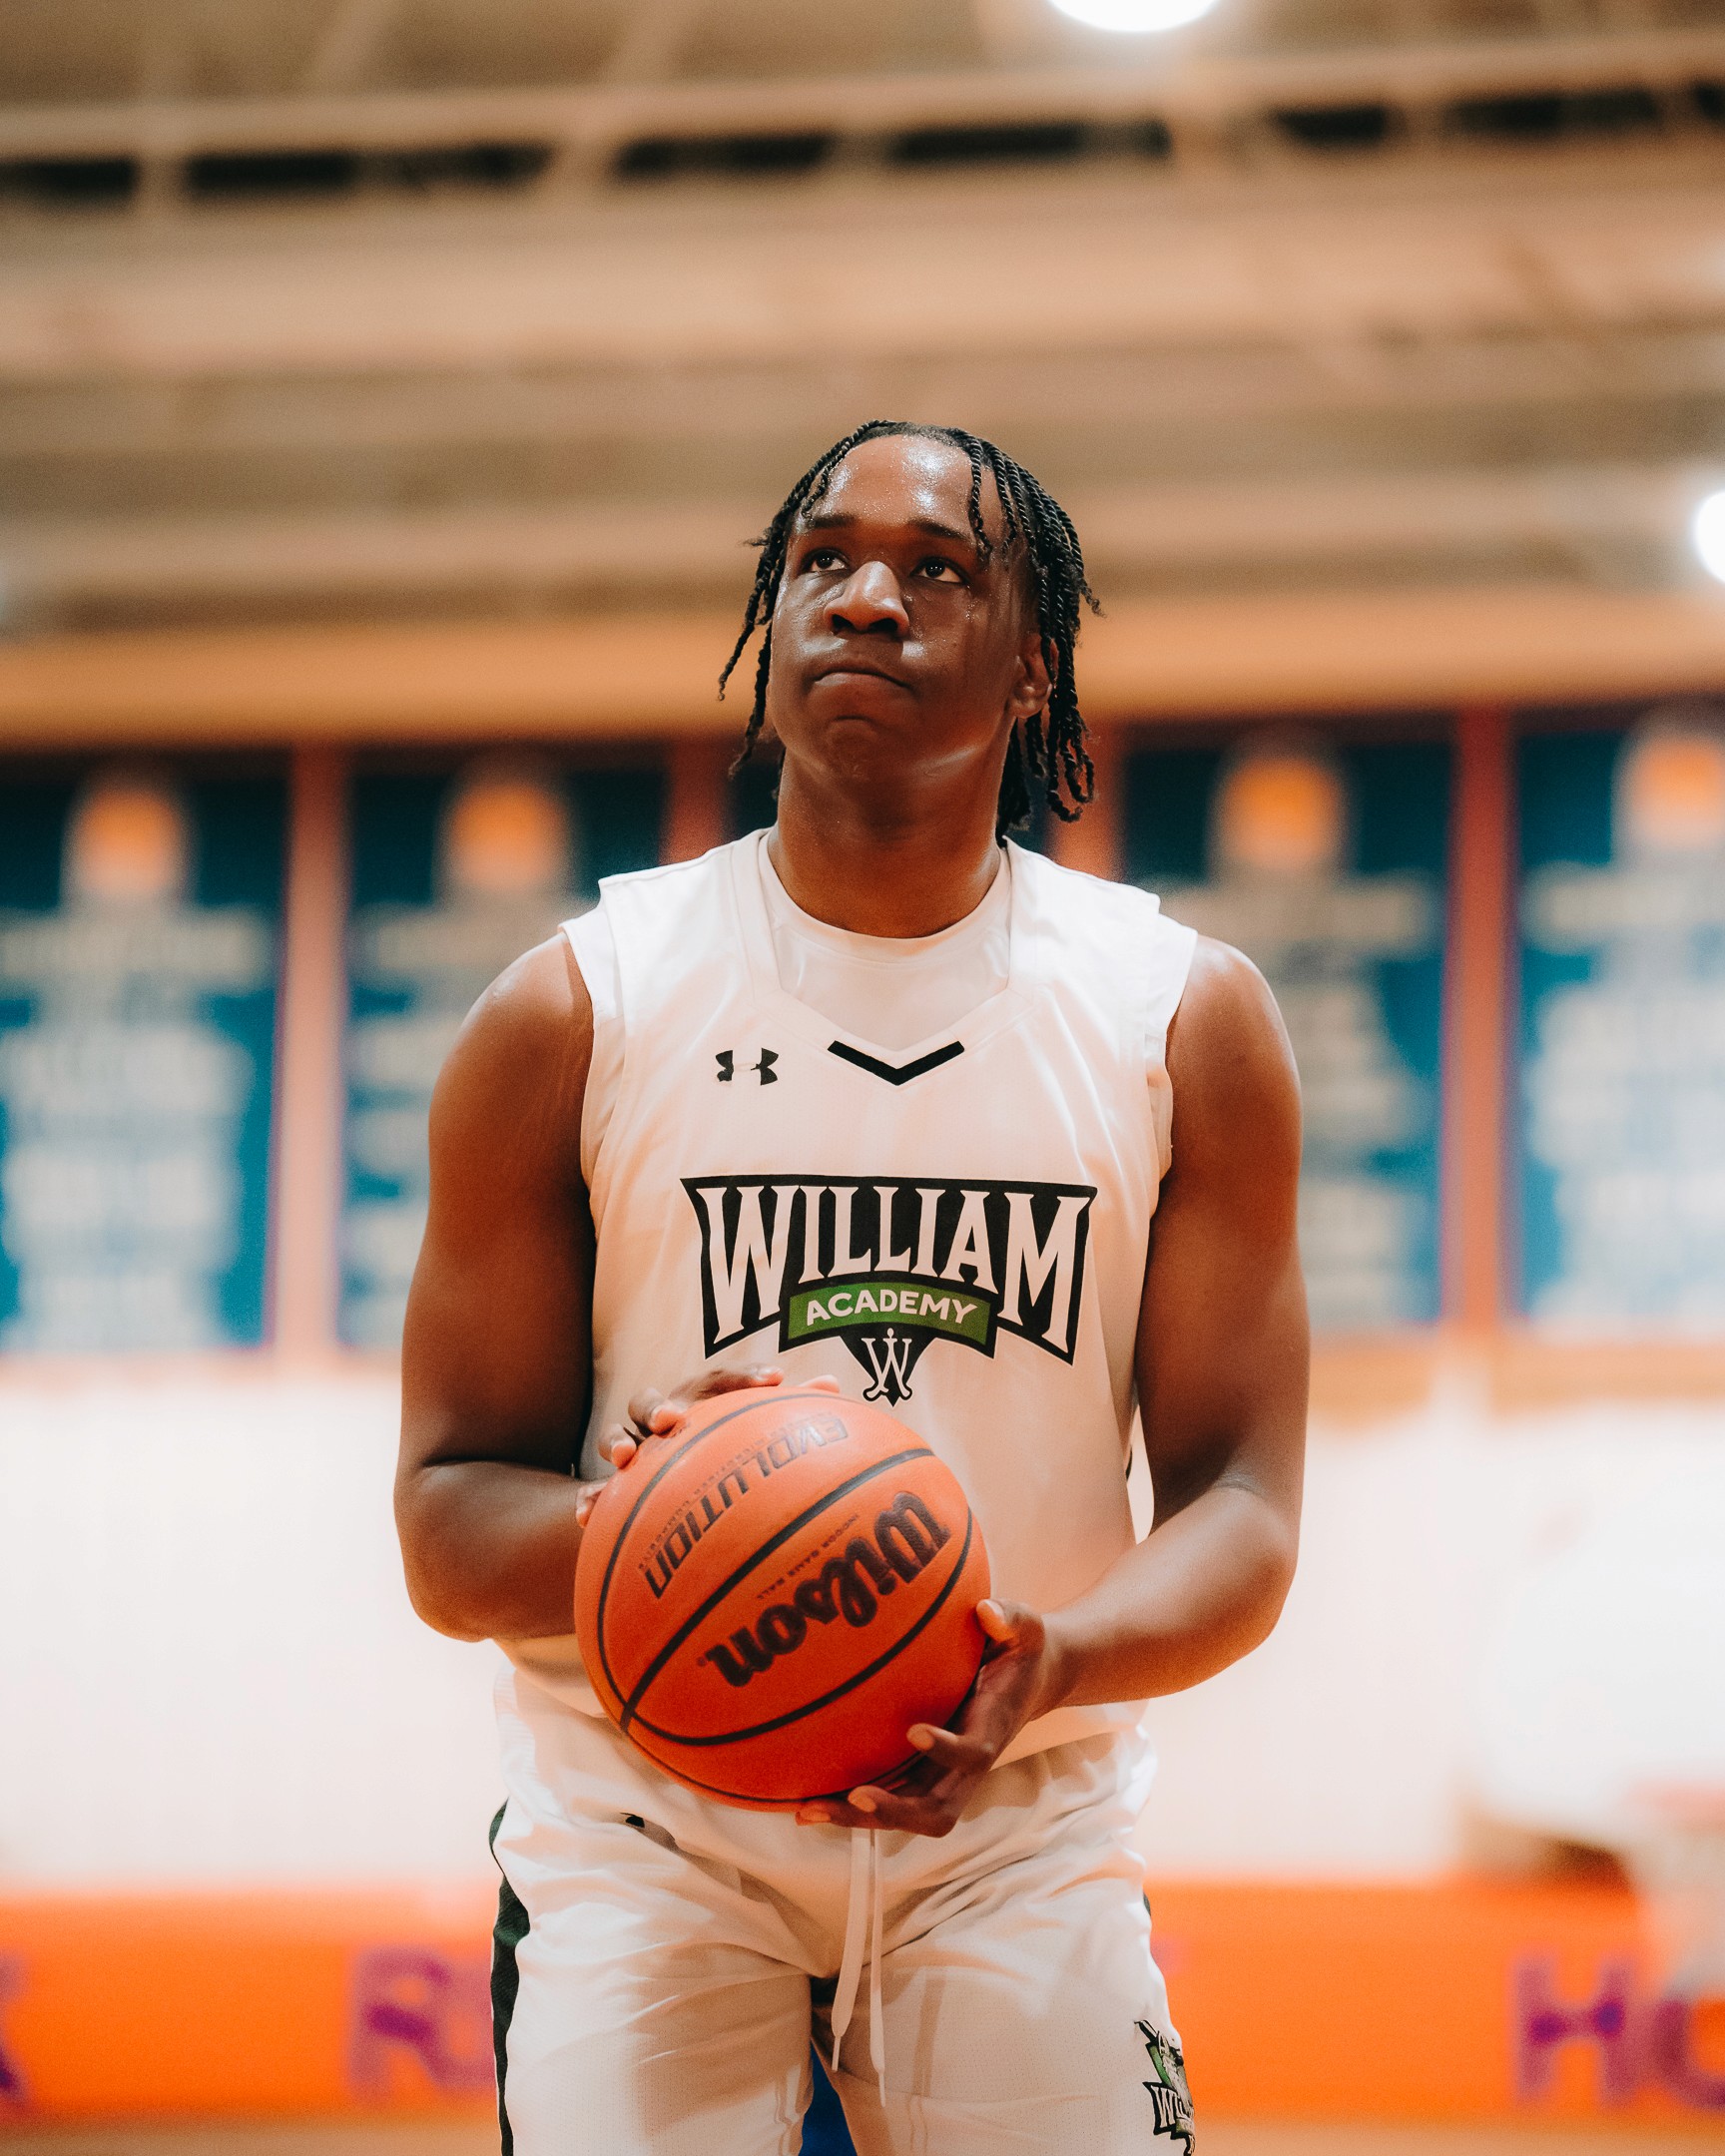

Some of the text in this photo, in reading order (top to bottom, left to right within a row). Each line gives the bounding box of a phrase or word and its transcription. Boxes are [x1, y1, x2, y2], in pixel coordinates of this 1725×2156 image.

[696, 1184, 1091, 1353] WILLIAM
[806, 1289, 978, 1327] ACADEMY
[644, 1417, 849, 1599] EVOLUTION
[705, 1491, 951, 1687] Wilson
